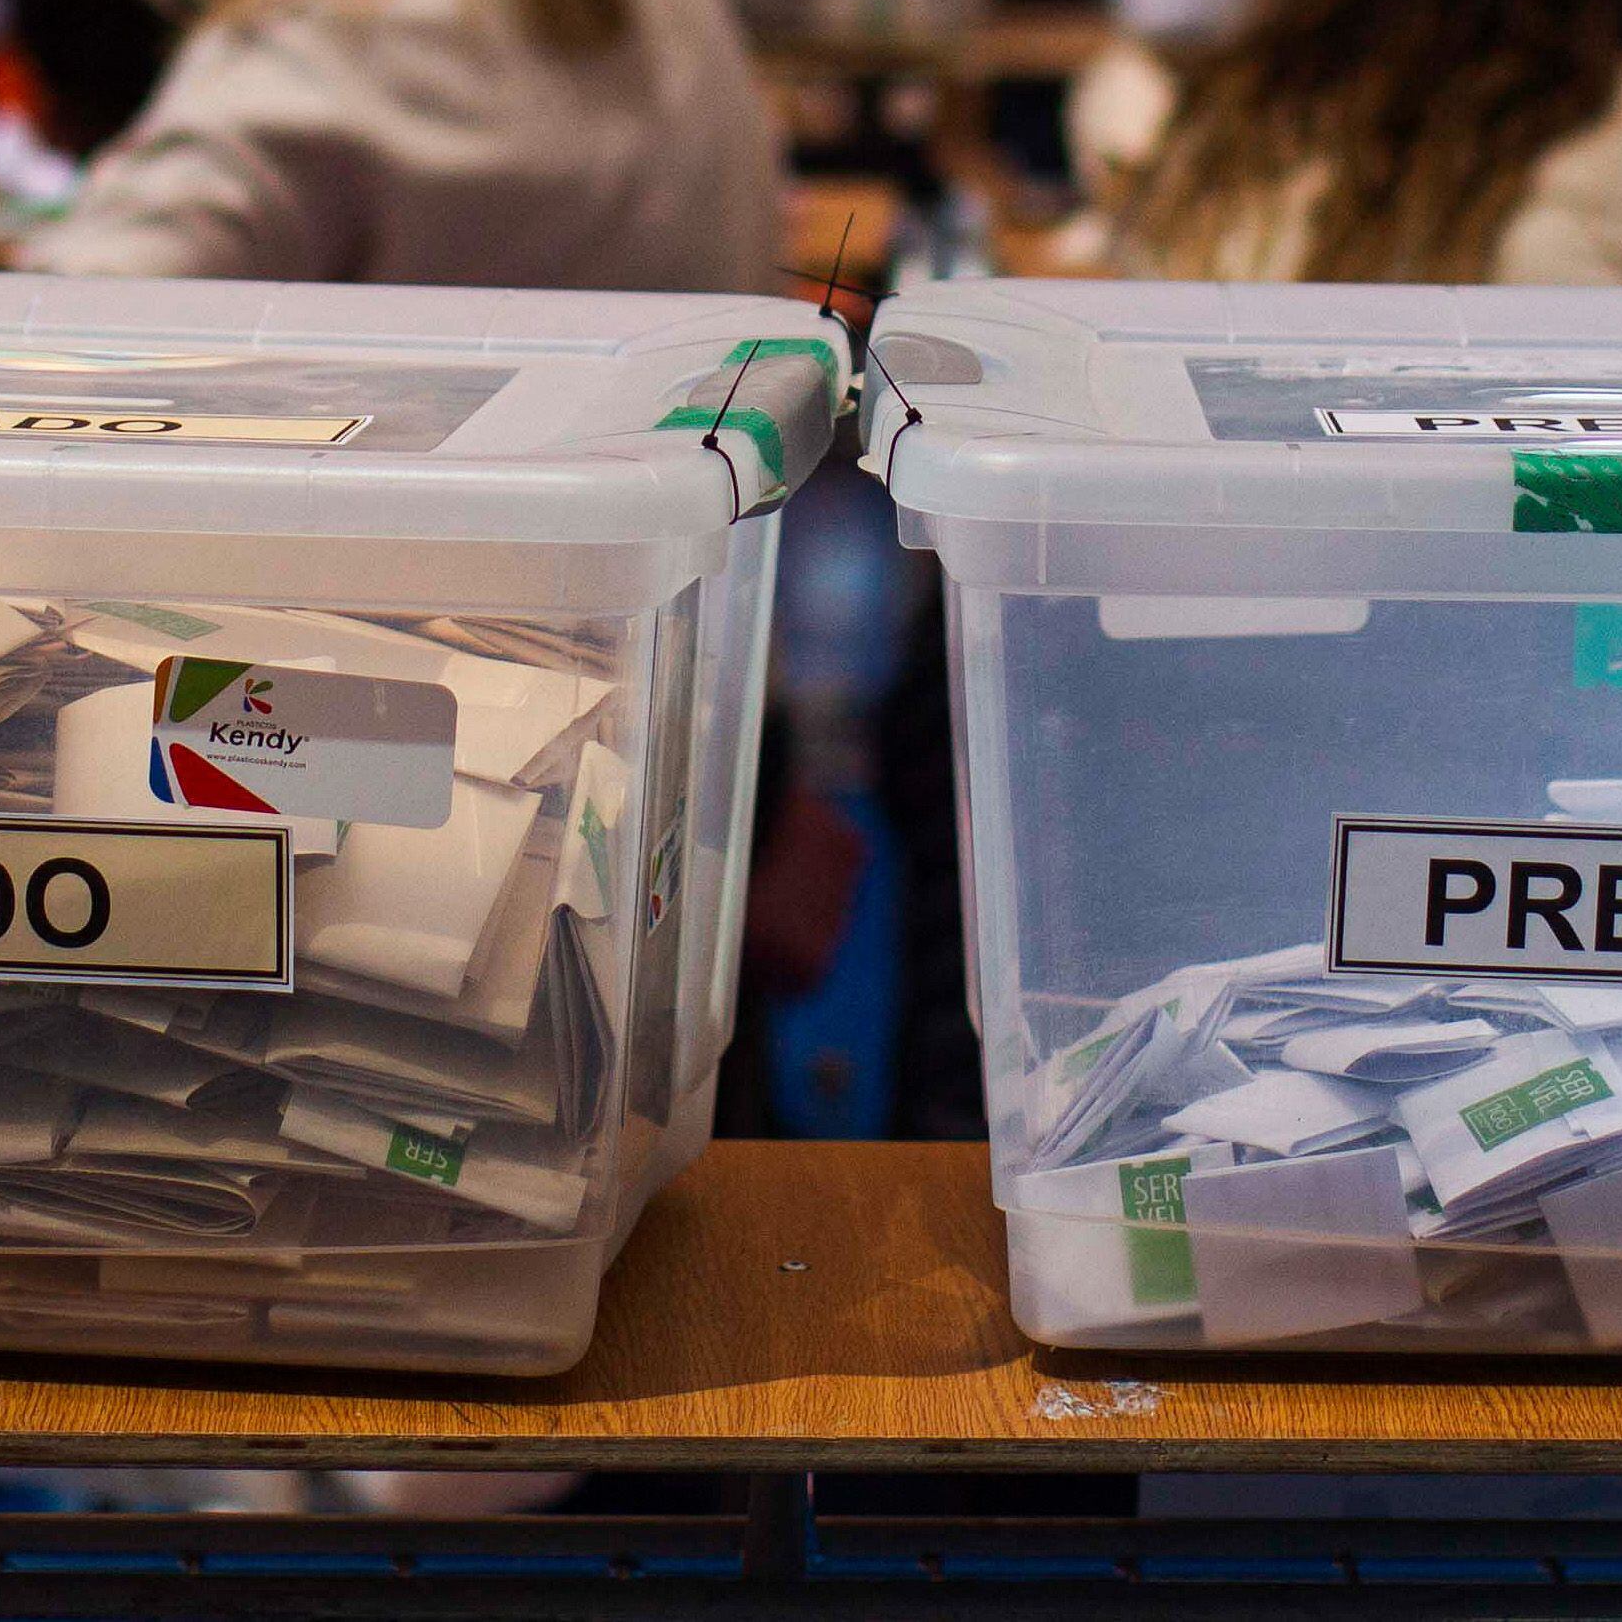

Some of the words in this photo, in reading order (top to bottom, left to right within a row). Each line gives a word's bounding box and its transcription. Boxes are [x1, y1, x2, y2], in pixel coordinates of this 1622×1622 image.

[209, 722, 303, 754] Kendy
[1529, 1079, 1565, 1118] VEL
[1554, 1069, 1596, 1101] SER
[1134, 1173, 1181, 1206] SER
